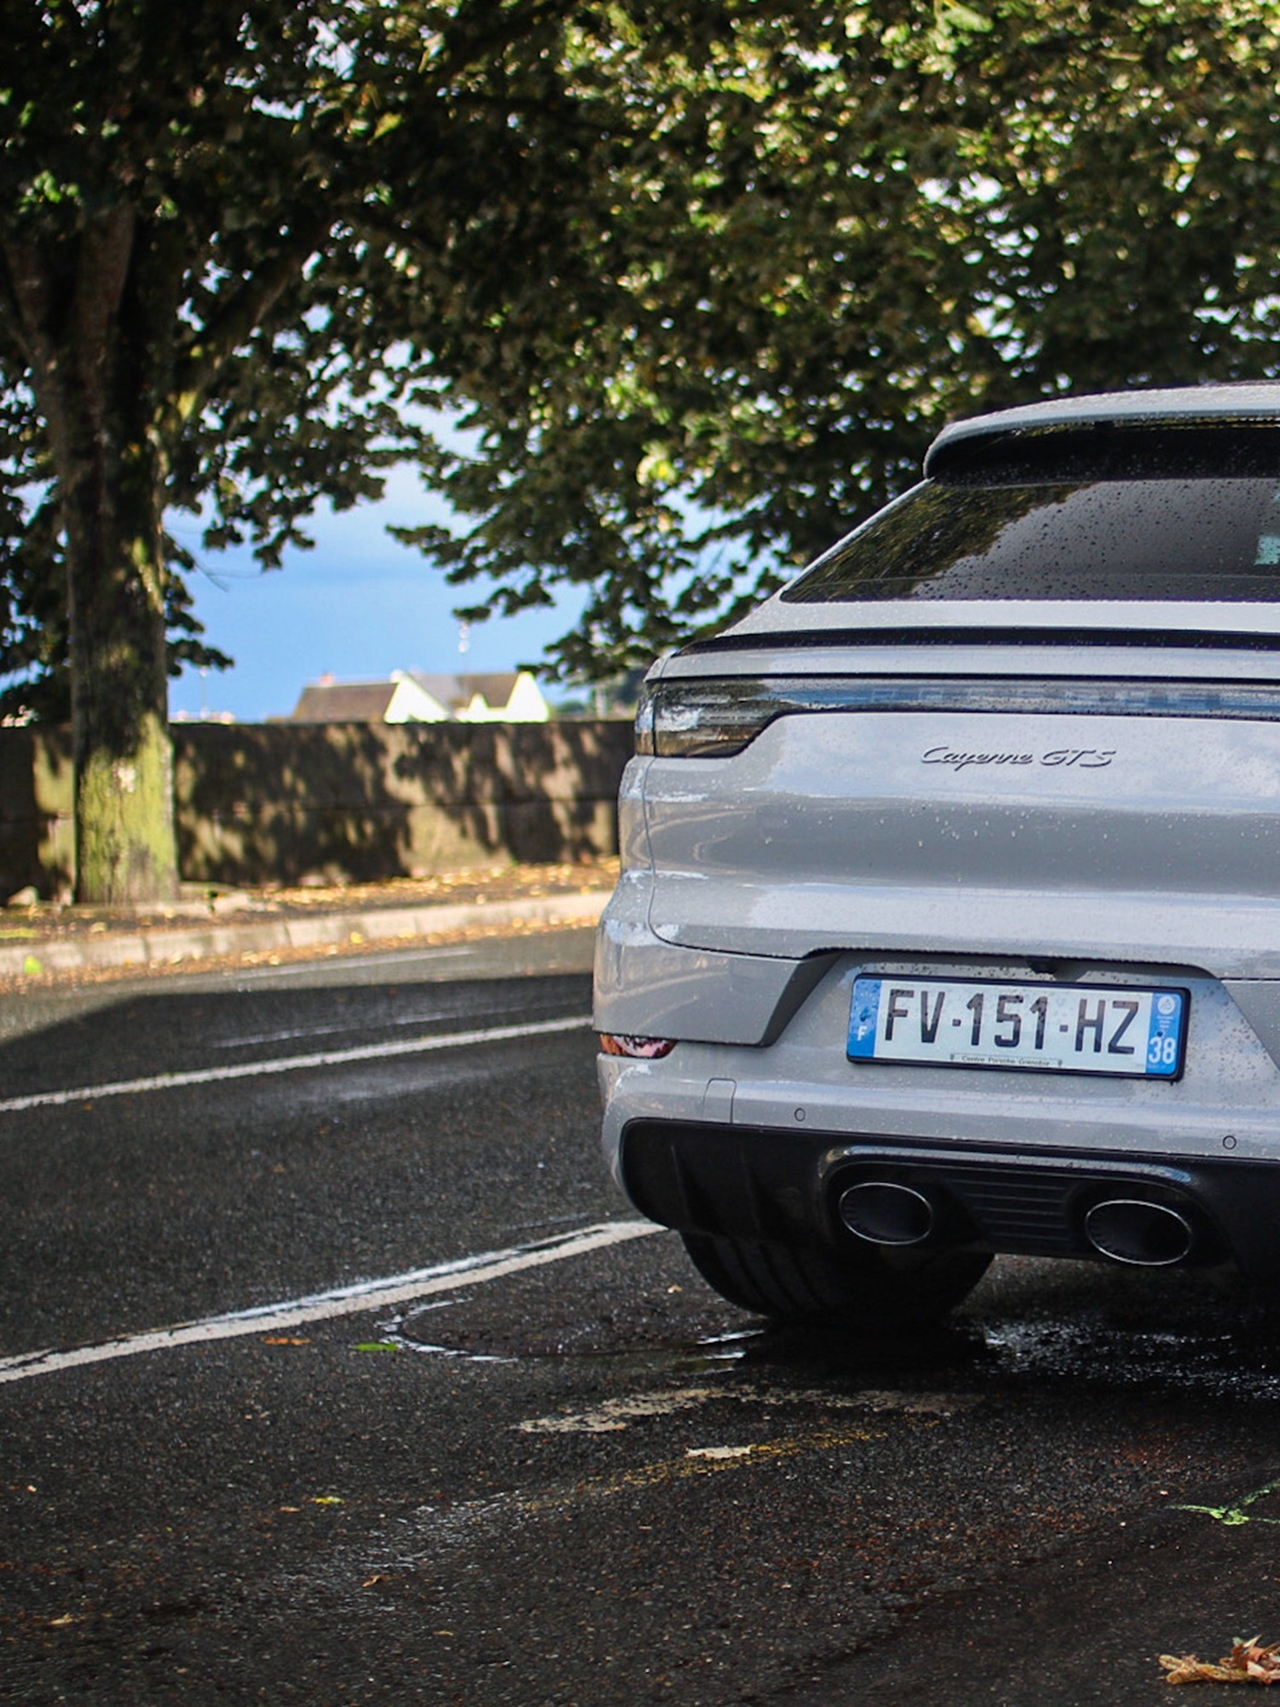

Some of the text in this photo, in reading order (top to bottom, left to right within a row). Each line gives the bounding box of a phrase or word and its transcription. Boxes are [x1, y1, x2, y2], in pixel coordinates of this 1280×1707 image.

[921, 746, 1117, 772] Cayenne GTS
[857, 1026, 868, 1041] F
[1147, 1036, 1177, 1065] 38
